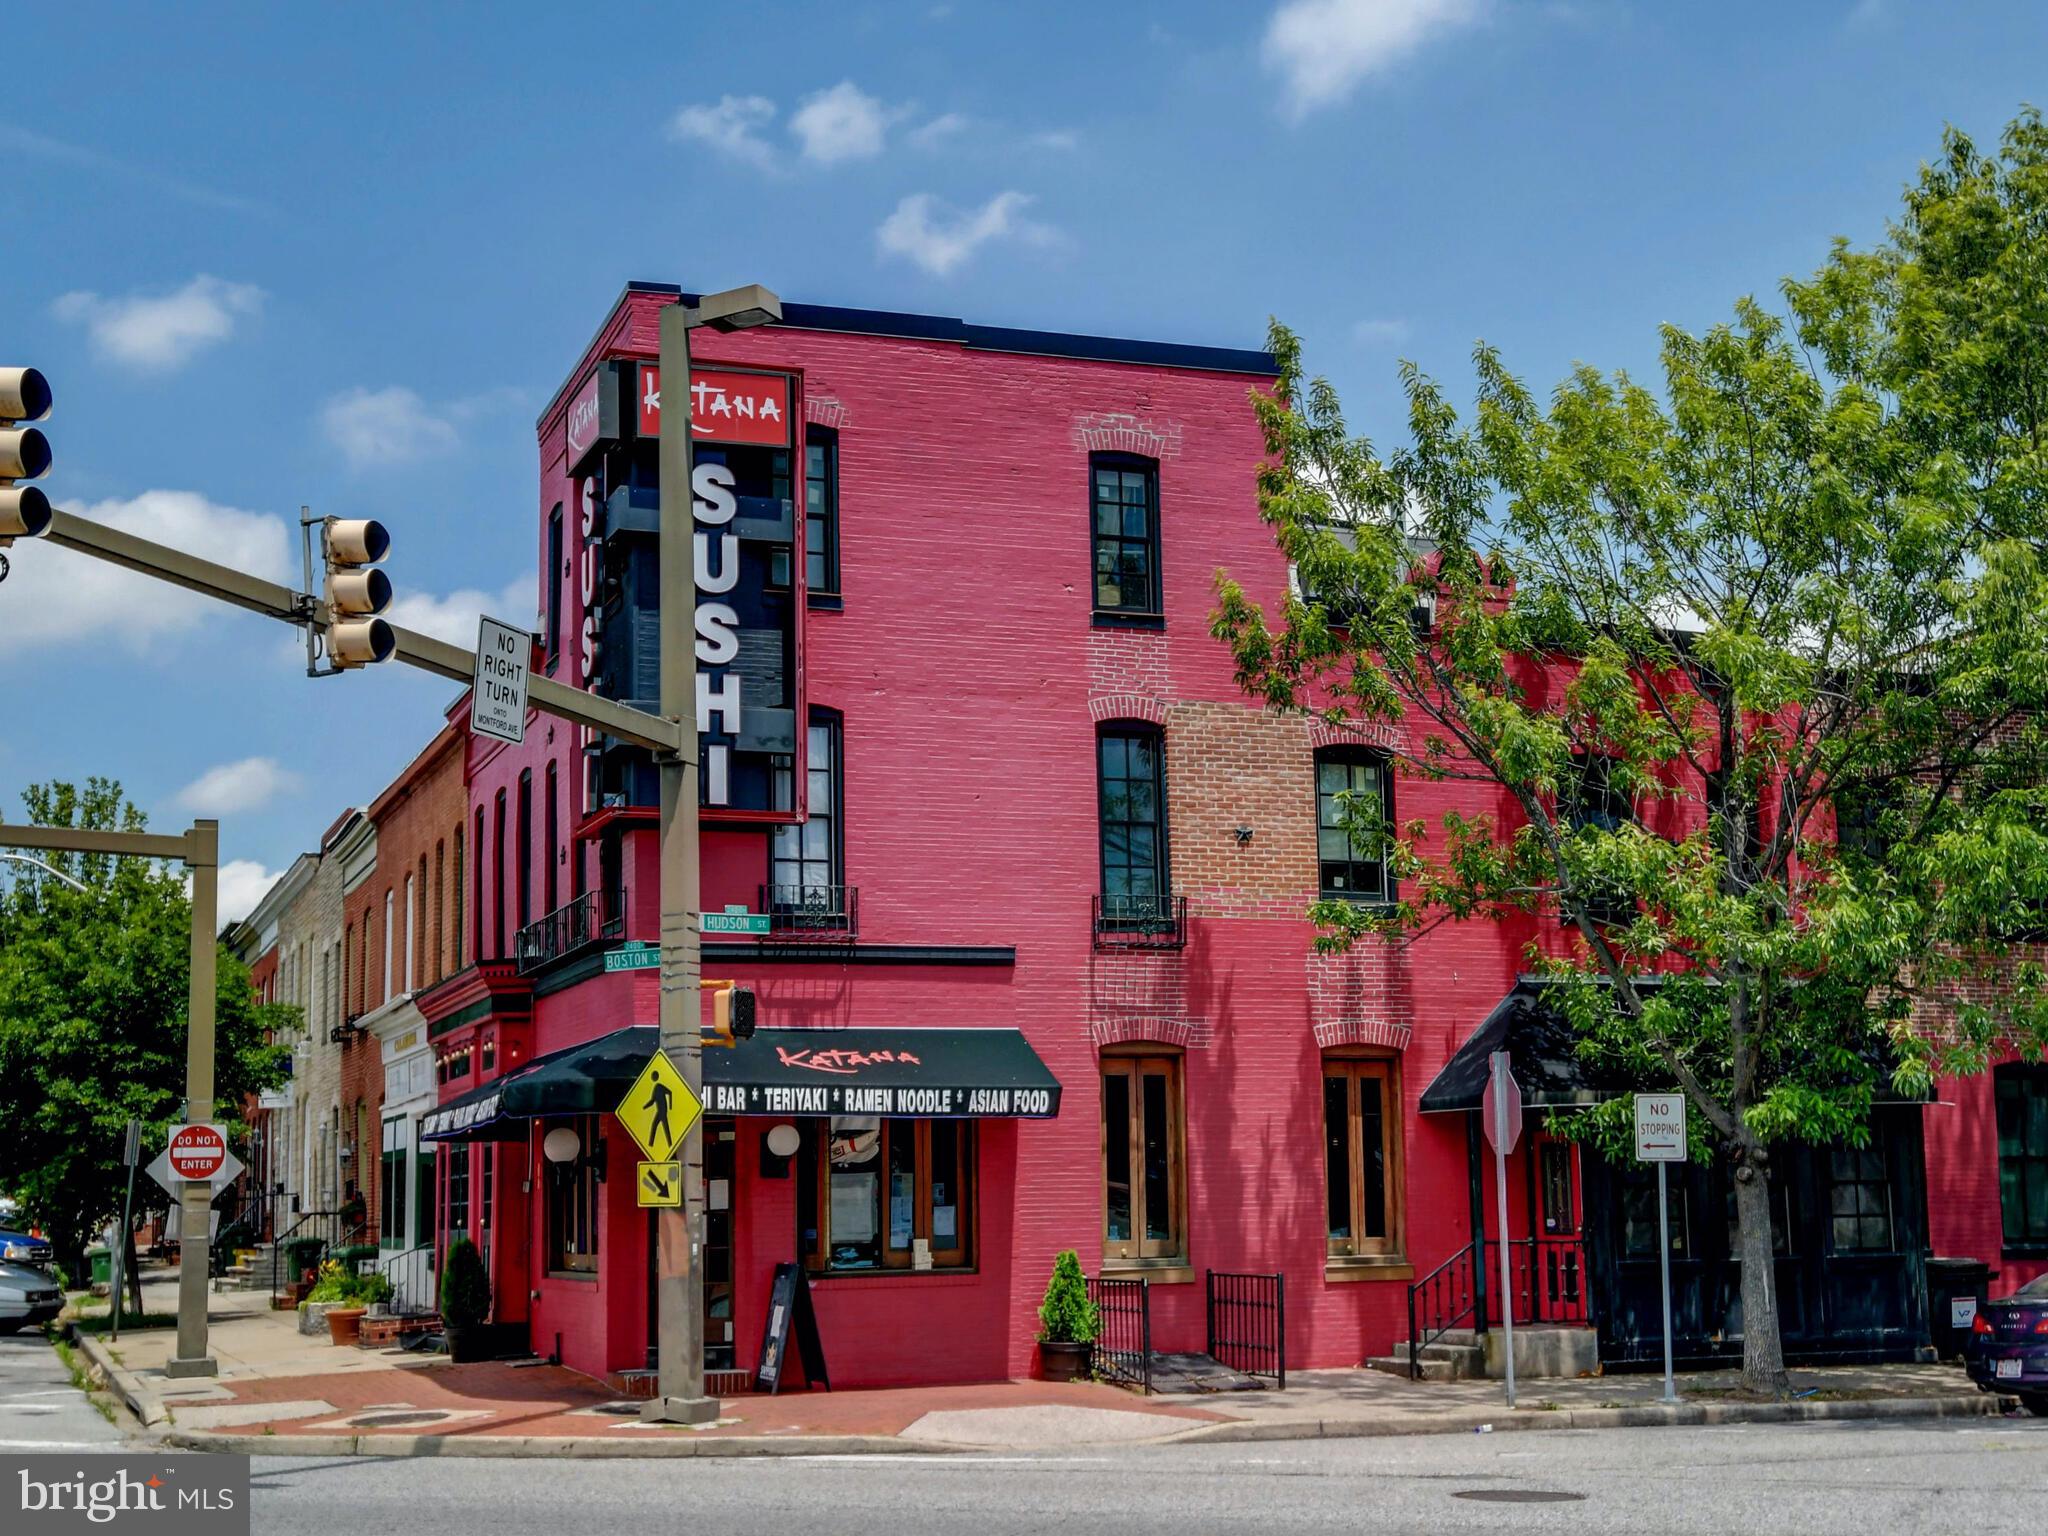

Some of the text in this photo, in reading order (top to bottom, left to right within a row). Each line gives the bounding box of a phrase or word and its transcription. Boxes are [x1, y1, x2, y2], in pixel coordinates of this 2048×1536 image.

[643, 372, 782, 433] KTANA
[692, 462, 741, 805] SUSHI
[497, 632, 515, 654] NO
[484, 654, 522, 682] RIGHT
[486, 680, 518, 707] TURN
[493, 707, 507, 718] ONTO
[478, 714, 507, 731] MONTFORD
[707, 916, 750, 930] HUDSON
[606, 952, 648, 969] BOSTON
[717, 1086, 746, 1111] BAR
[764, 1087, 828, 1112] TERIYAKI
[845, 1088, 893, 1112] RAMEN
[897, 1088, 952, 1113] NOODLE
[968, 1089, 1010, 1113] ASIAN
[1013, 1089, 1050, 1113] FOOD
[1650, 1103, 1669, 1116] NO
[1640, 1123, 1680, 1135] STOPPING
[178, 1135, 218, 1145] DO NOT
[181, 1160, 213, 1170] ENTER
